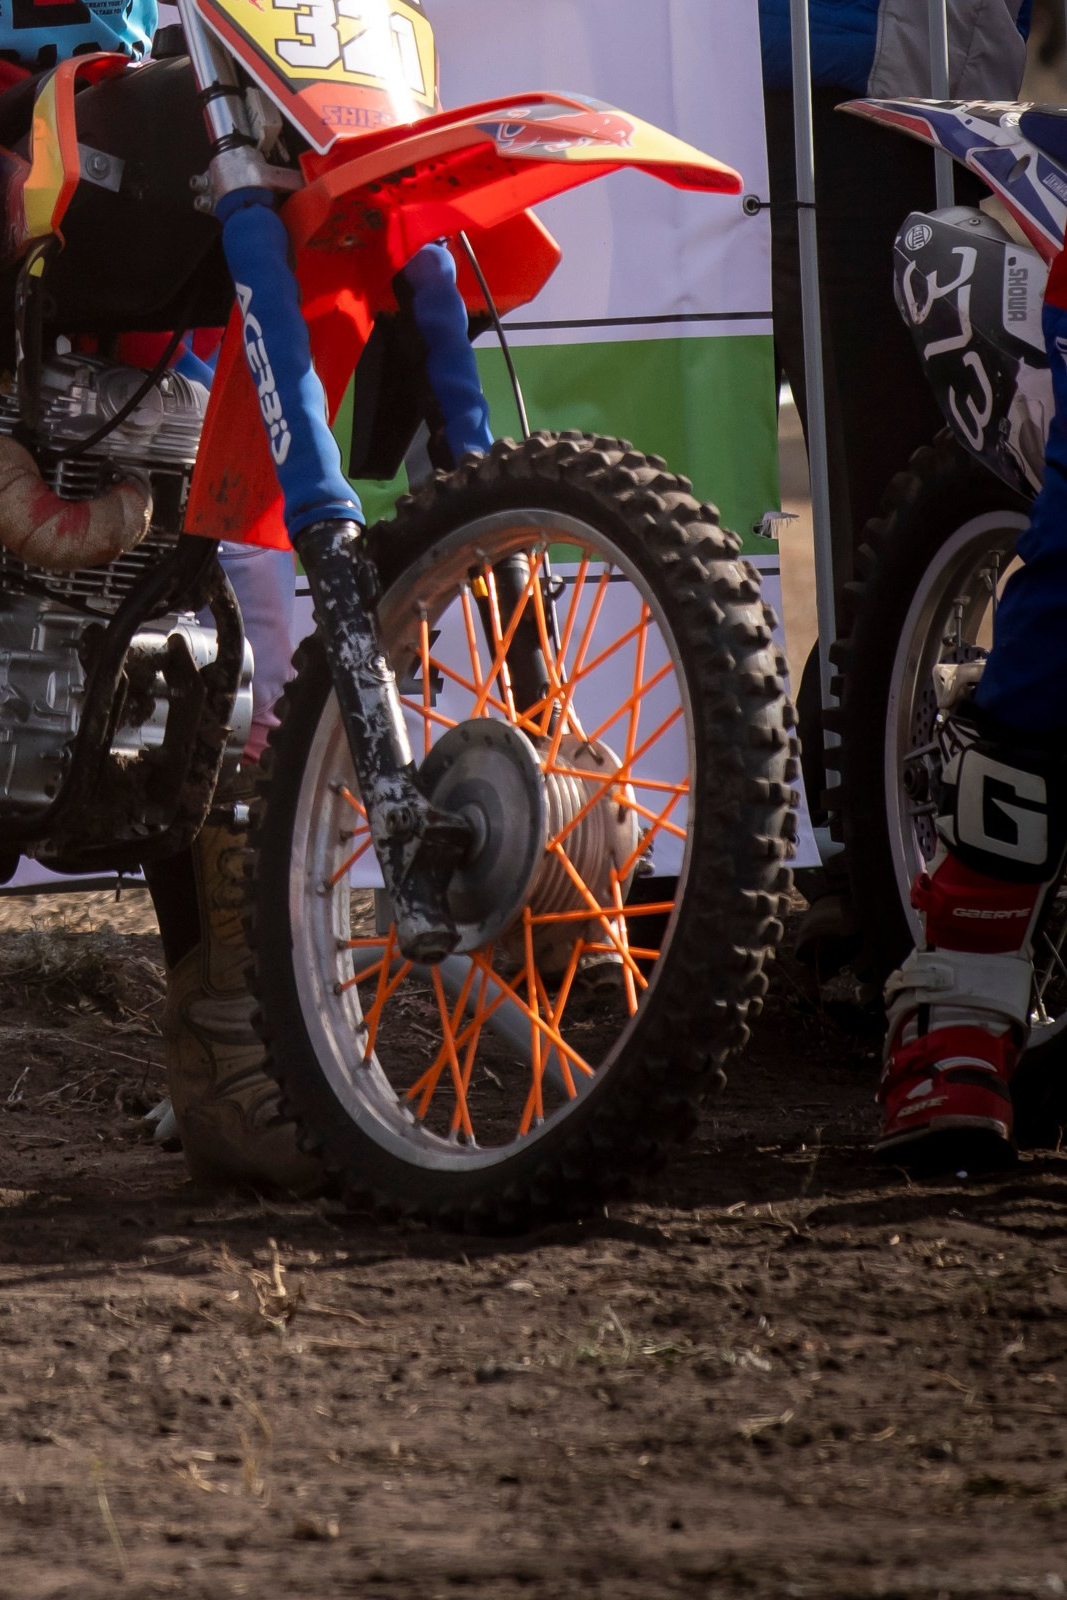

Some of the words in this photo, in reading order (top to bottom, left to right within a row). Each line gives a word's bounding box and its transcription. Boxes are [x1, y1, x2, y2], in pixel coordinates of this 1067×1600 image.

[322, 104, 393, 130] SHIF
[1007, 267, 1028, 322] SHOWA
[953, 906, 1032, 921] GAERNE
